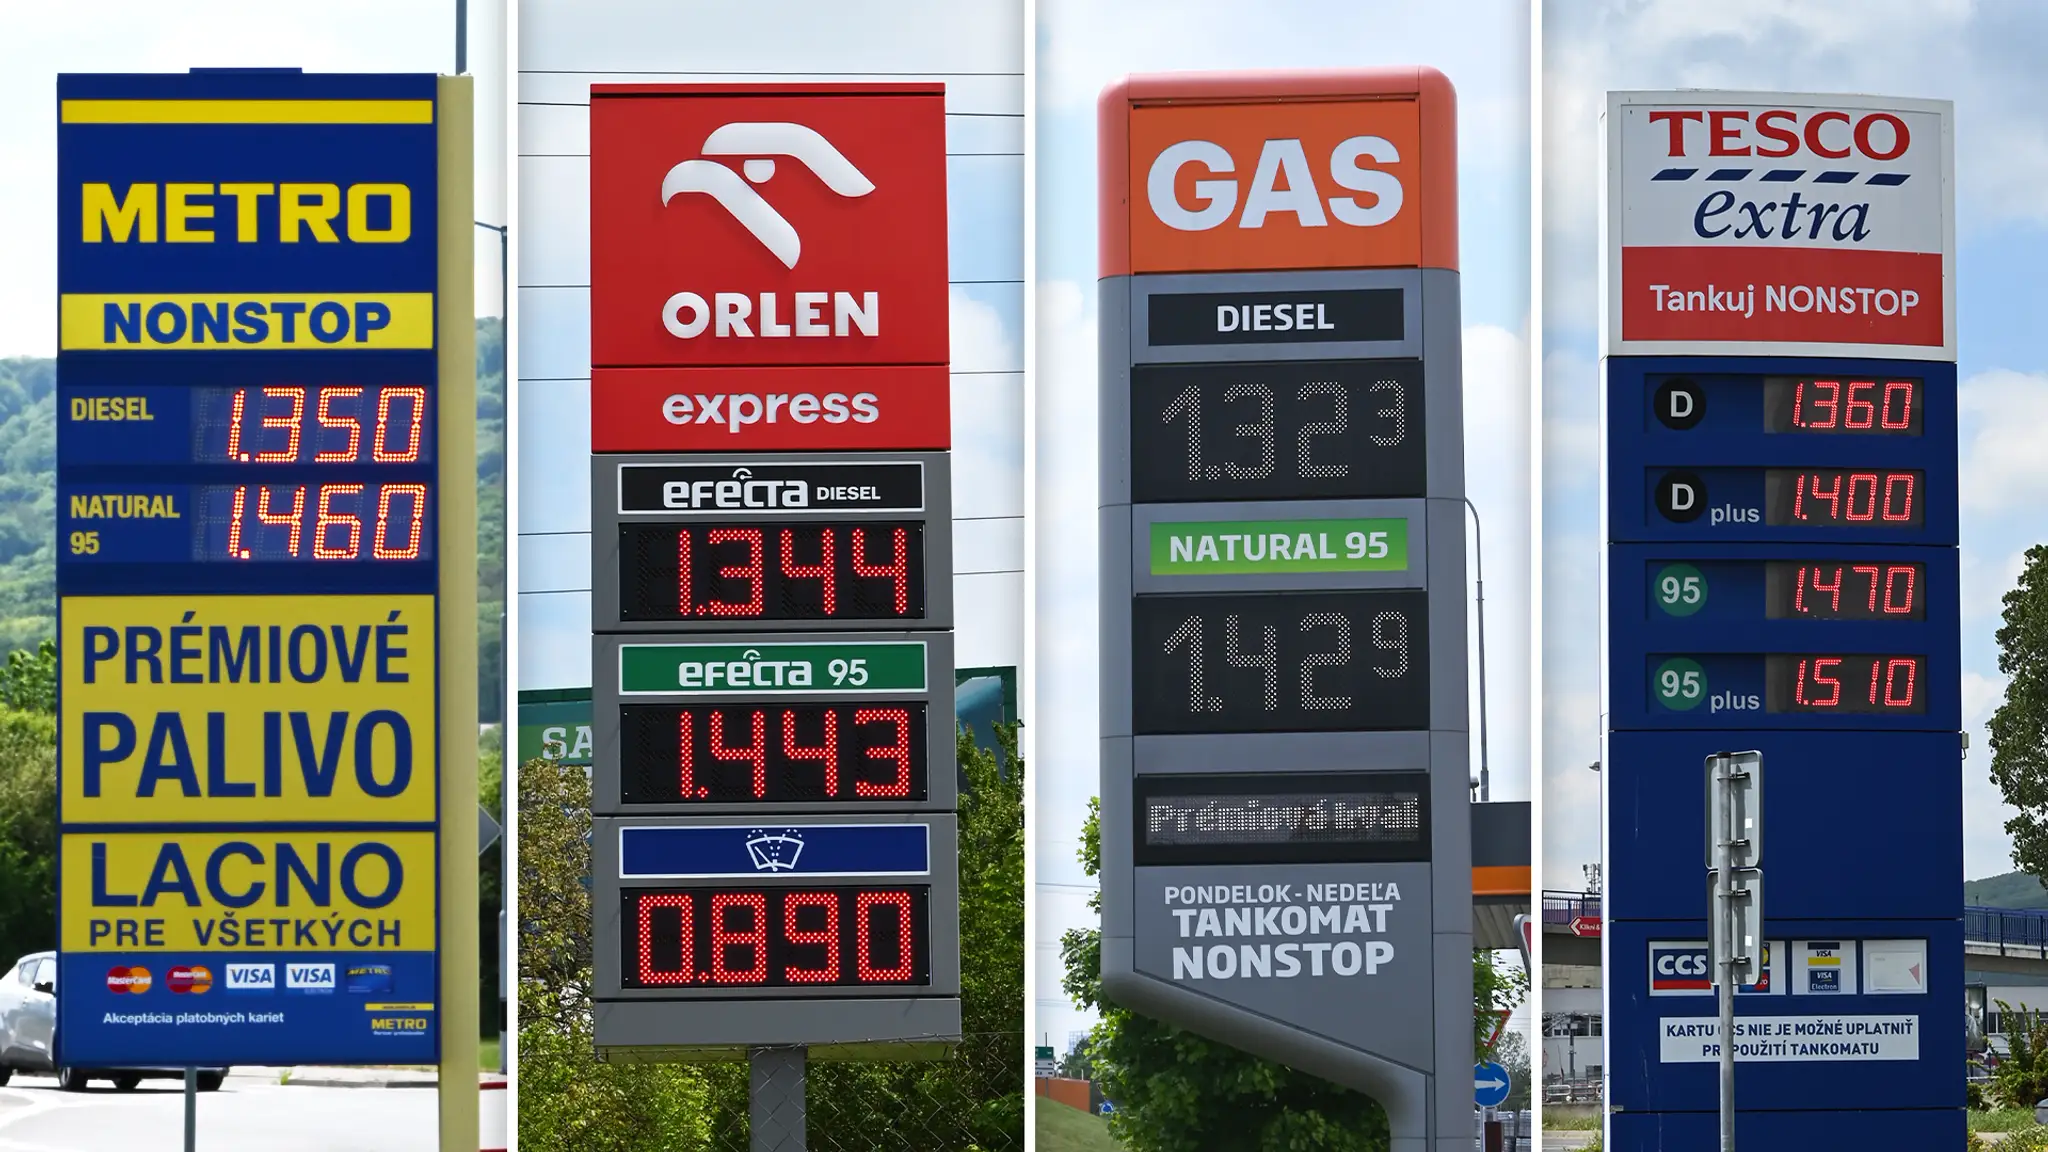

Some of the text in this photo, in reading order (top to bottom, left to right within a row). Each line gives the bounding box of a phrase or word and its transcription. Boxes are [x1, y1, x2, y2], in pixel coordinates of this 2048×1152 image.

[1649, 110, 1911, 160] TESCO
[1147, 135, 1404, 231] GAS
[82, 183, 411, 243] METRO
[1693, 190, 1870, 242] extra
[662, 291, 879, 339] ORLEN
[1216, 304, 1335, 332] DIESEL
[1650, 284, 1919, 317] Tankuj NONSTOP
[103, 301, 391, 344] NONSTOP
[71, 398, 154, 421] DIESEL
[662, 391, 880, 433] express
[1670, 391, 1693, 418] D
[1792, 381, 1913, 430] 1.360
[228, 387, 426, 463] 1.350
[70, 495, 180, 519] NATURAL
[816, 485, 881, 501] DIESEL
[1671, 484, 1760, 526] D plus
[1794, 474, 1915, 522] 1.400
[228, 484, 426, 560] 1.460
[70, 532, 100, 555] 95
[1169, 531, 1389, 562] NATURAL 95
[679, 528, 908, 616] 1.344
[1661, 576, 1701, 604] 95
[1795, 566, 1915, 613] 1.470
[83, 611, 410, 684] PRÉMIOVÉ
[828, 659, 869, 687] 95
[1660, 670, 1760, 714] 95 plus
[1796, 658, 1916, 707] 1.510
[82, 709, 413, 799] PALIVO
[681, 708, 910, 798] 1.443
[91, 840, 405, 909] LACNO
[1164, 884, 1291, 904] PONDELOK
[1306, 882, 1401, 903] NEDEĽA
[90, 911, 401, 947] PRE VŠETKÝCH
[639, 892, 912, 984] 0.890
[1172, 903, 1394, 938] TANKOMAT
[231, 968, 273, 983] VISA
[291, 968, 333, 983] VISA
[1172, 940, 1395, 980] NONSTOP
[1657, 955, 1707, 975] CCS
[107, 976, 152, 985] MasterCard
[1811, 983, 1838, 991] Electron
[103, 1012, 285, 1026] Akceptácia platobných kariet
[371, 1018, 427, 1030] METRO
[1667, 1024, 1714, 1037] KARTU
[1749, 1023, 1772, 1036] NIE
[1775, 1023, 1792, 1036] JE
[1795, 1019, 1843, 1036] MOŽNÉ
[1846, 1018, 1913, 1035] UPLATNIŤ
[1703, 1044, 1721, 1056] PR
[1790, 1042, 1879, 1056] TANKOMATU
